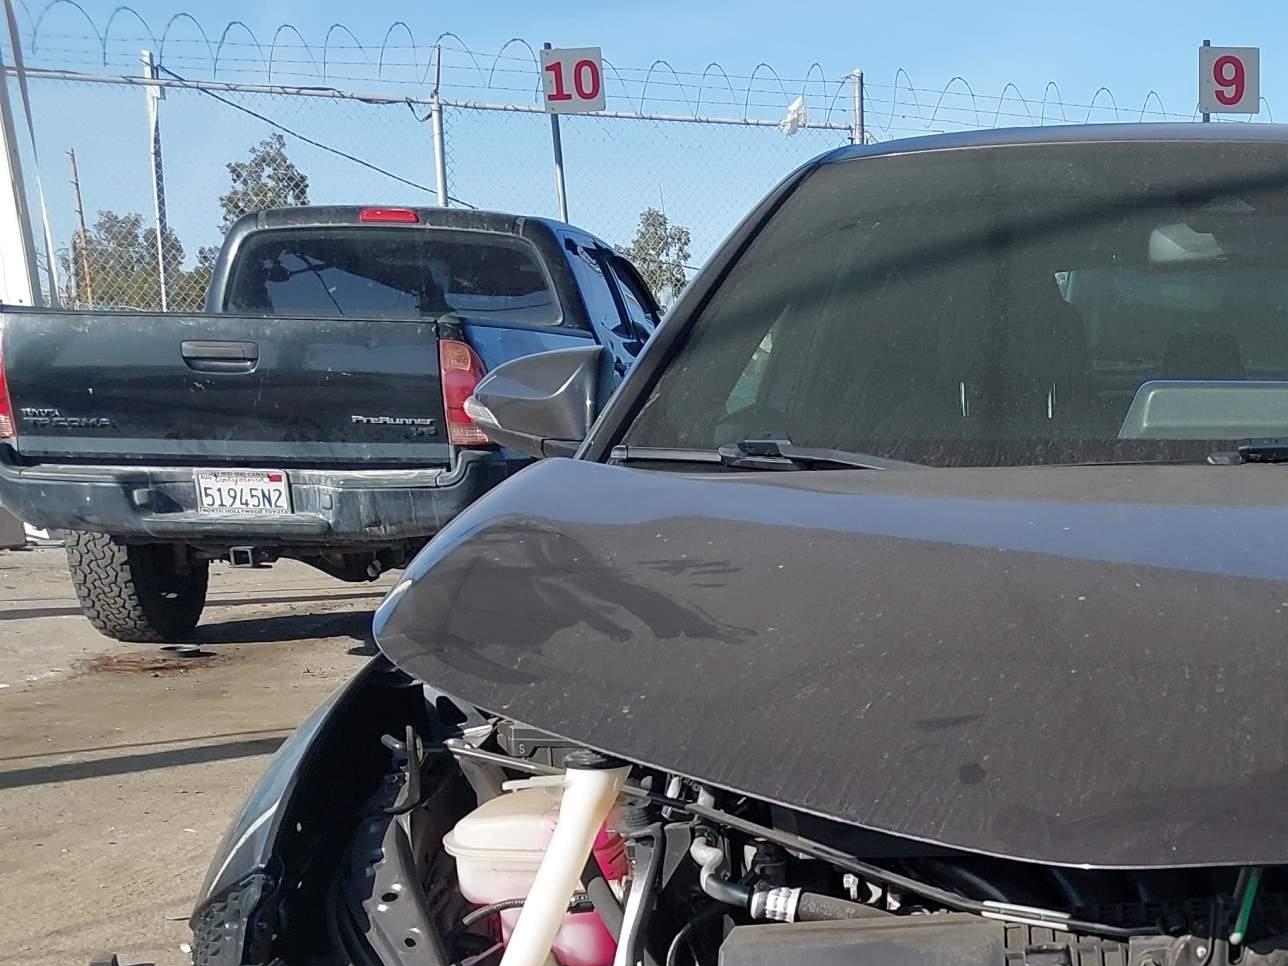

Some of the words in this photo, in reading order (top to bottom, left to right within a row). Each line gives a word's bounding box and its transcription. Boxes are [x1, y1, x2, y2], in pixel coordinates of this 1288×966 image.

[545, 60, 600, 101] 10
[1213, 55, 1245, 105] 9
[351, 415, 435, 425] PreRunner
[203, 486, 284, 508] 51945N2
